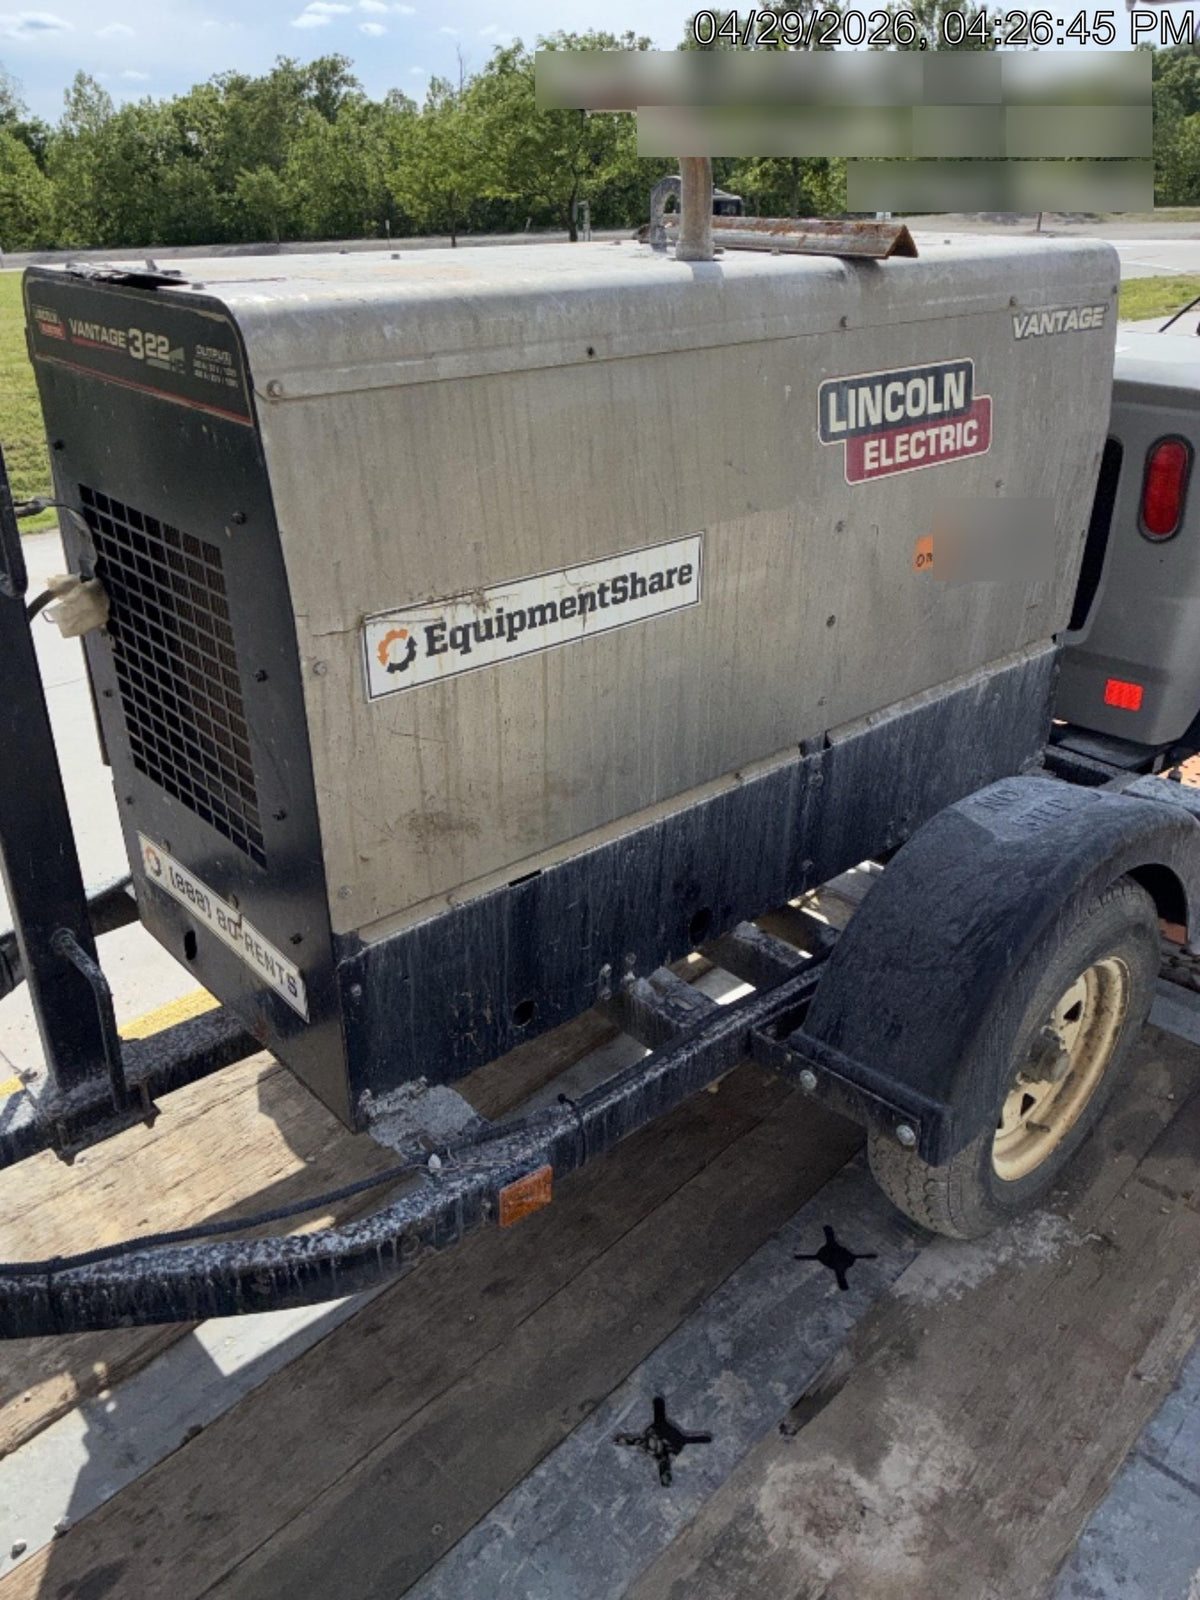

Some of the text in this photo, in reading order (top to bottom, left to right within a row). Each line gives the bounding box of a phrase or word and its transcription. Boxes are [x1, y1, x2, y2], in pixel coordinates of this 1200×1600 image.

[68, 317, 127, 349] VANTAGE
[127, 327, 170, 360] 322
[1012, 306, 1104, 341] VANTAGE
[829, 371, 966, 434] LINCOLN
[864, 419, 980, 471] ELECTRIC
[425, 562, 694, 657] EquipmentShare
